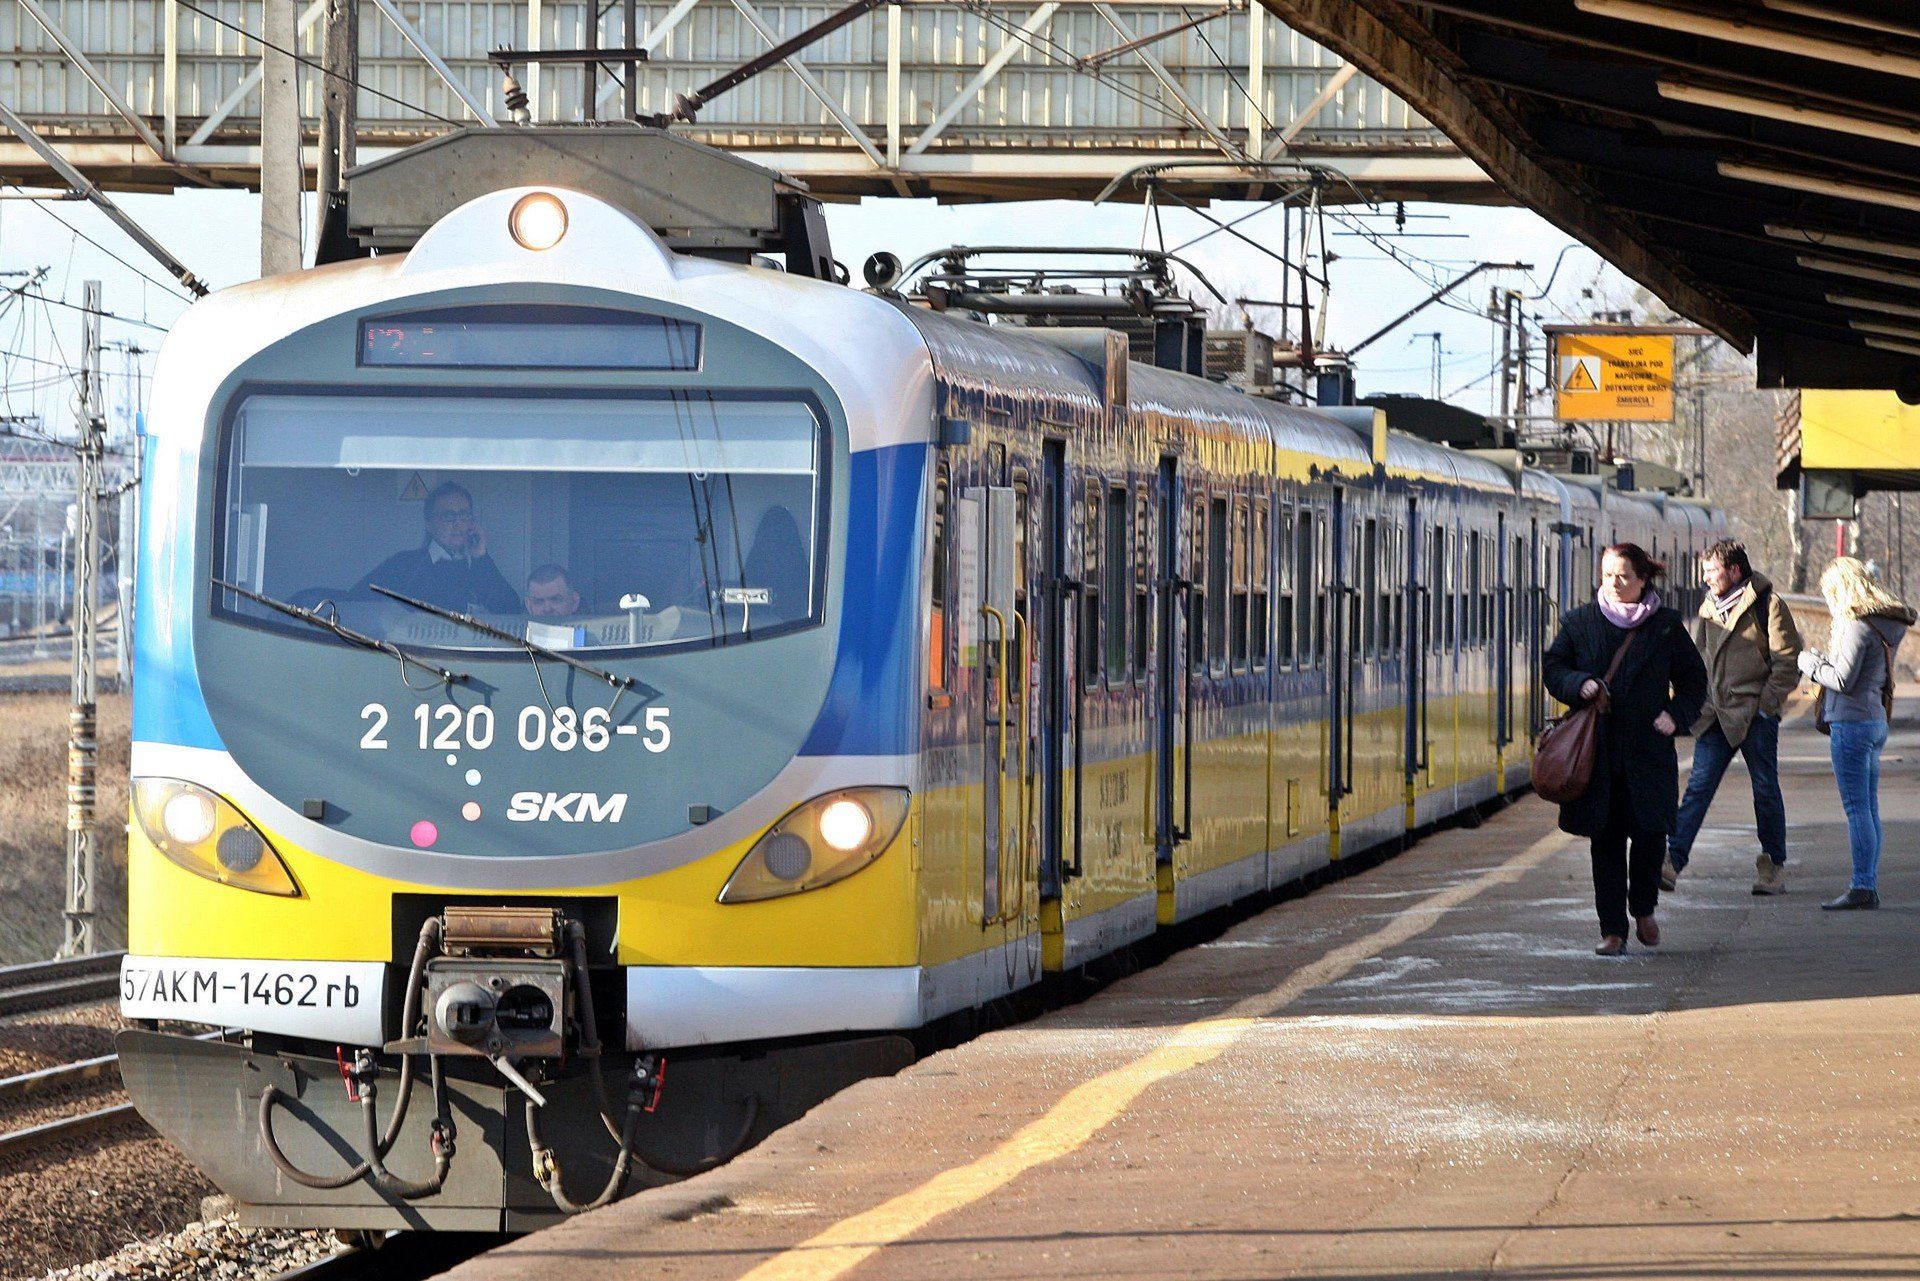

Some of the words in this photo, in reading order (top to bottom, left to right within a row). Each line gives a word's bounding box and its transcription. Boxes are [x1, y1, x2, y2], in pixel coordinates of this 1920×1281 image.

[360, 702, 389, 750] 2
[414, 703, 494, 750] 120
[517, 705, 671, 753] 086-5
[506, 791, 628, 822] SKM
[121, 969, 360, 1008] 57AKM-1462rb
